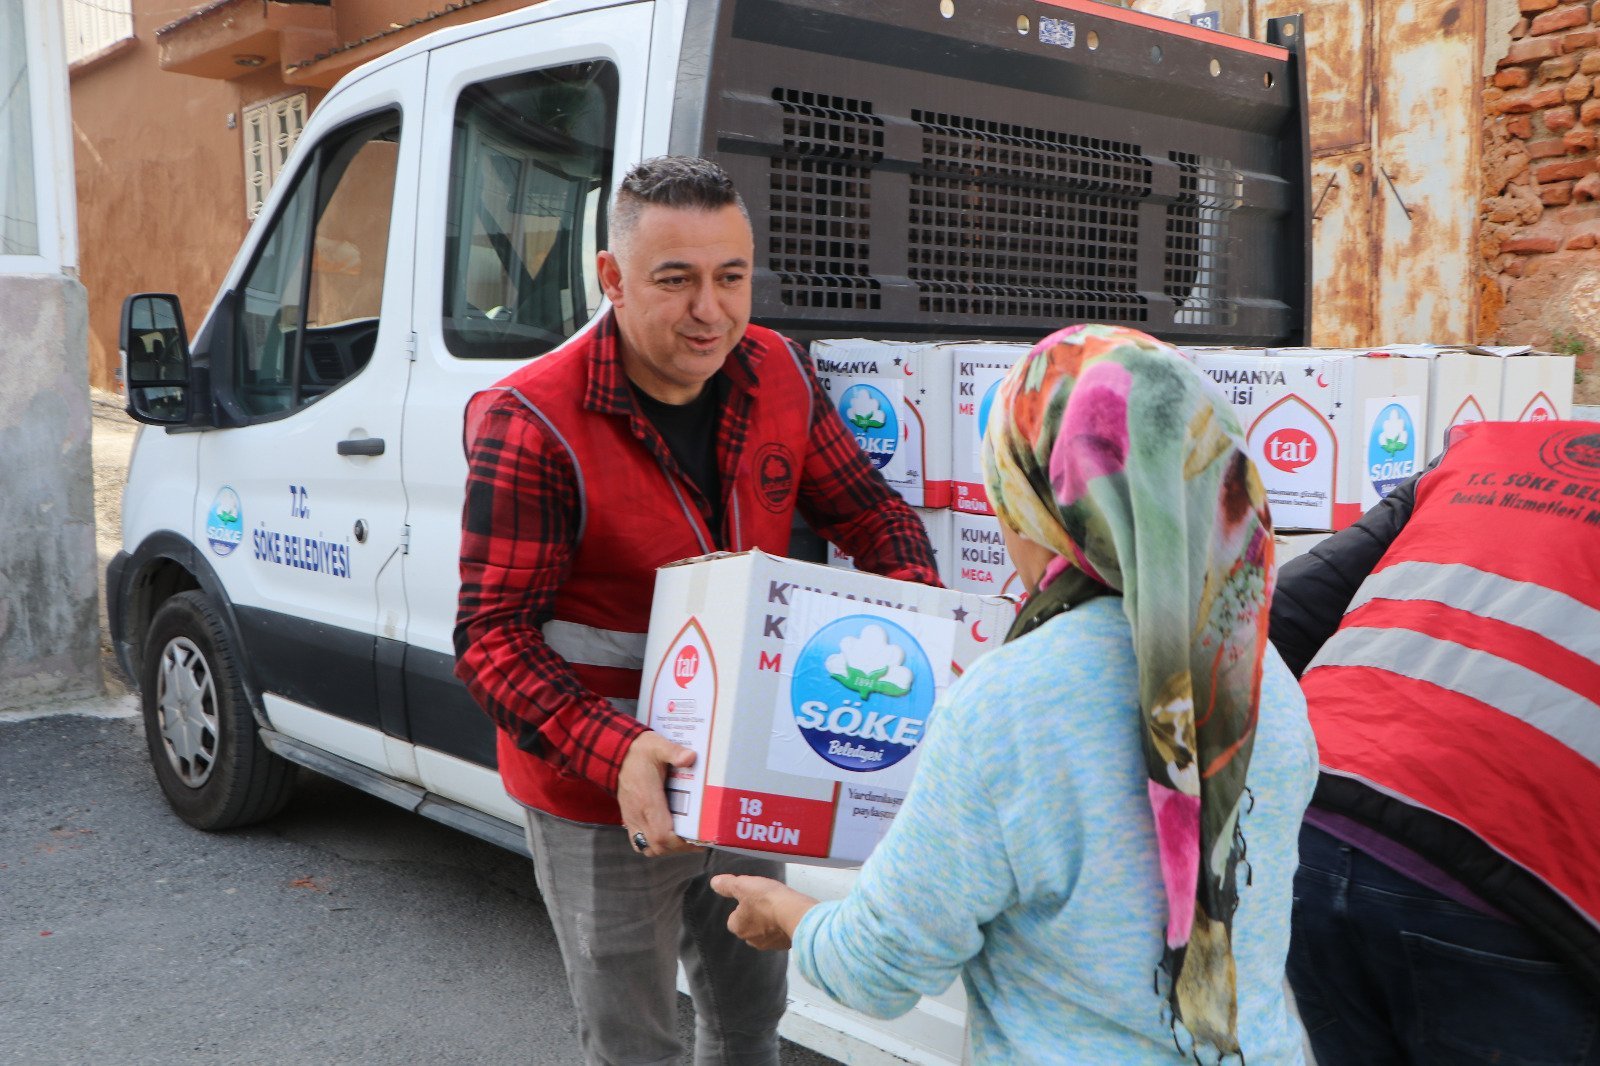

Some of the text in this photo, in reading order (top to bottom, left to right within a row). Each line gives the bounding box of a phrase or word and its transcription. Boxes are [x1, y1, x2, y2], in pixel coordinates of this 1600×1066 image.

[855, 432, 896, 453] ÖKE
[1268, 437, 1311, 463] tat
[1371, 458, 1413, 480] SÖKE
[957, 486, 968, 496] 18
[1467, 473, 1496, 486] T.C.
[1503, 472, 1558, 492] SÖKE
[957, 497, 987, 512] ÜRÜN
[1500, 493, 1585, 520] Hizmetleri
[207, 526, 242, 543] SÖKE
[961, 528, 1005, 545] KUMA
[254, 521, 351, 578] SÖKE BELEDİYESİ
[961, 546, 1005, 565] KOLİSİ
[961, 568, 994, 583] MEGA
[677, 655, 697, 677] tat
[799, 700, 925, 746] SÖKE
[828, 740, 884, 762] Belediyesi
[739, 797, 762, 816] 18
[736, 818, 800, 846] ÜRÜN
